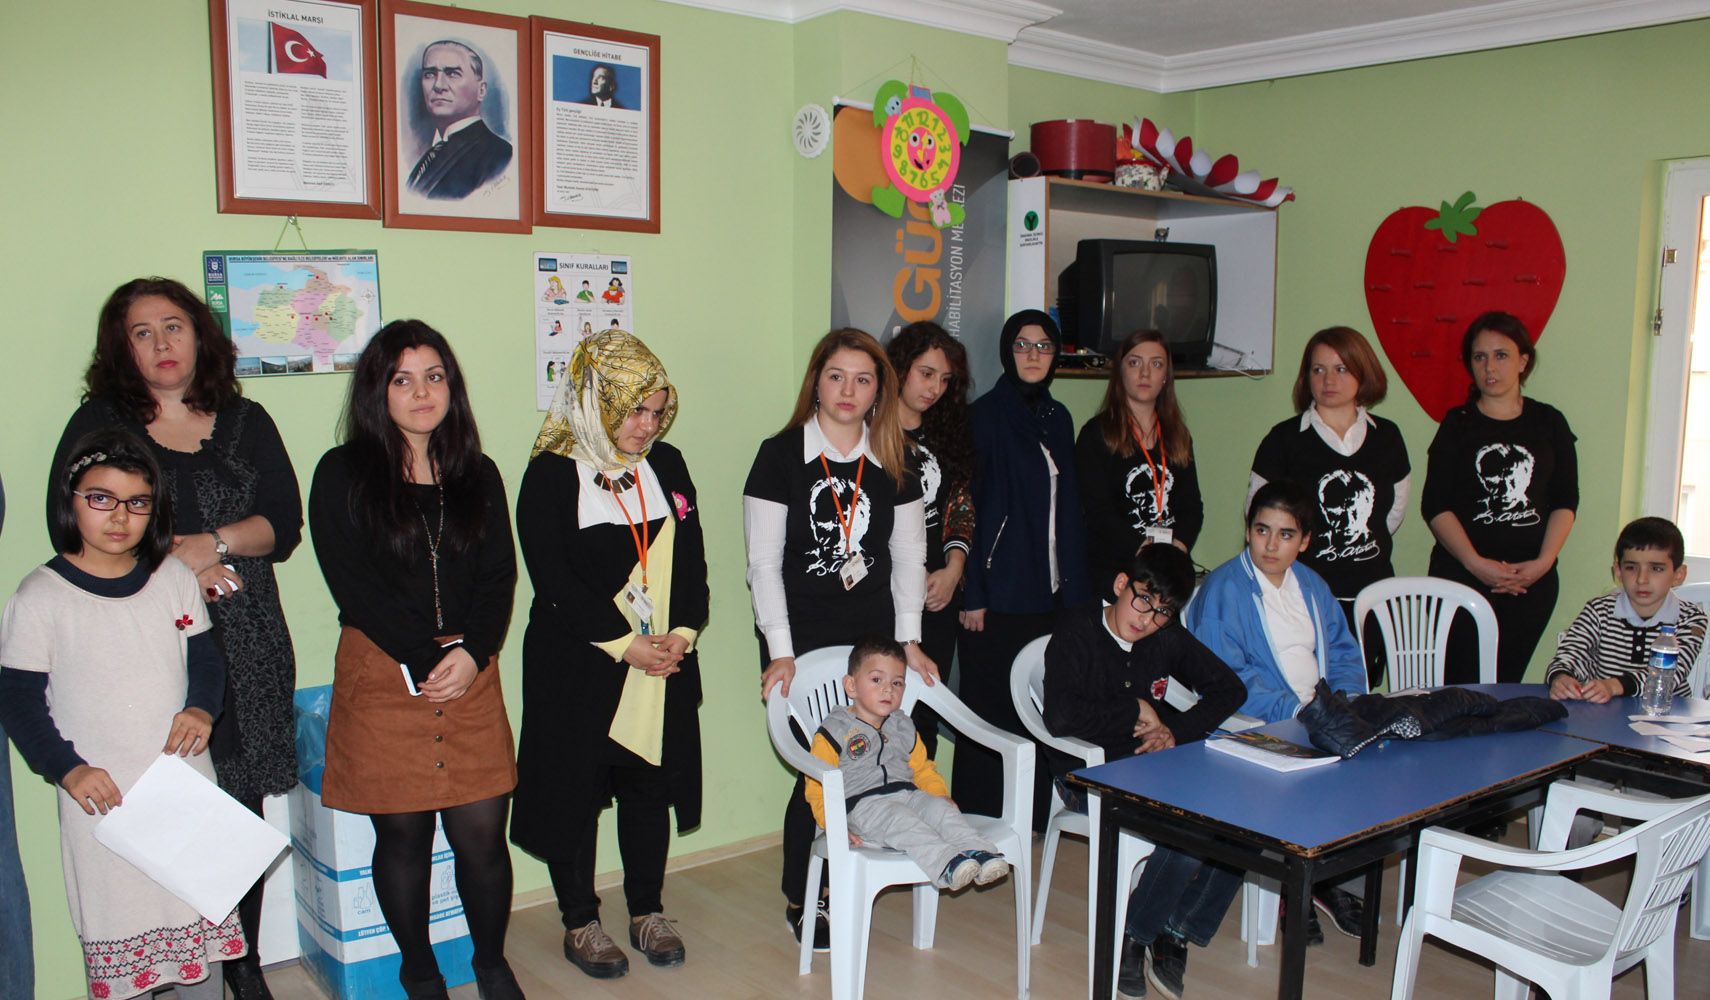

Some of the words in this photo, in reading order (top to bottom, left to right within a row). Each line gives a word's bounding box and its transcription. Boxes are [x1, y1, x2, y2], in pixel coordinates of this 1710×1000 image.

[901, 112, 914, 128] 11
[917, 110, 930, 128] 12
[932, 118, 940, 131] 1
[895, 126, 908, 142] 10
[937, 128, 947, 141] 2
[893, 144, 902, 158] 9
[900, 160, 908, 176] 8
[910, 170, 918, 184] 7
[920, 170, 928, 188] 6
[930, 170, 940, 185] 5
